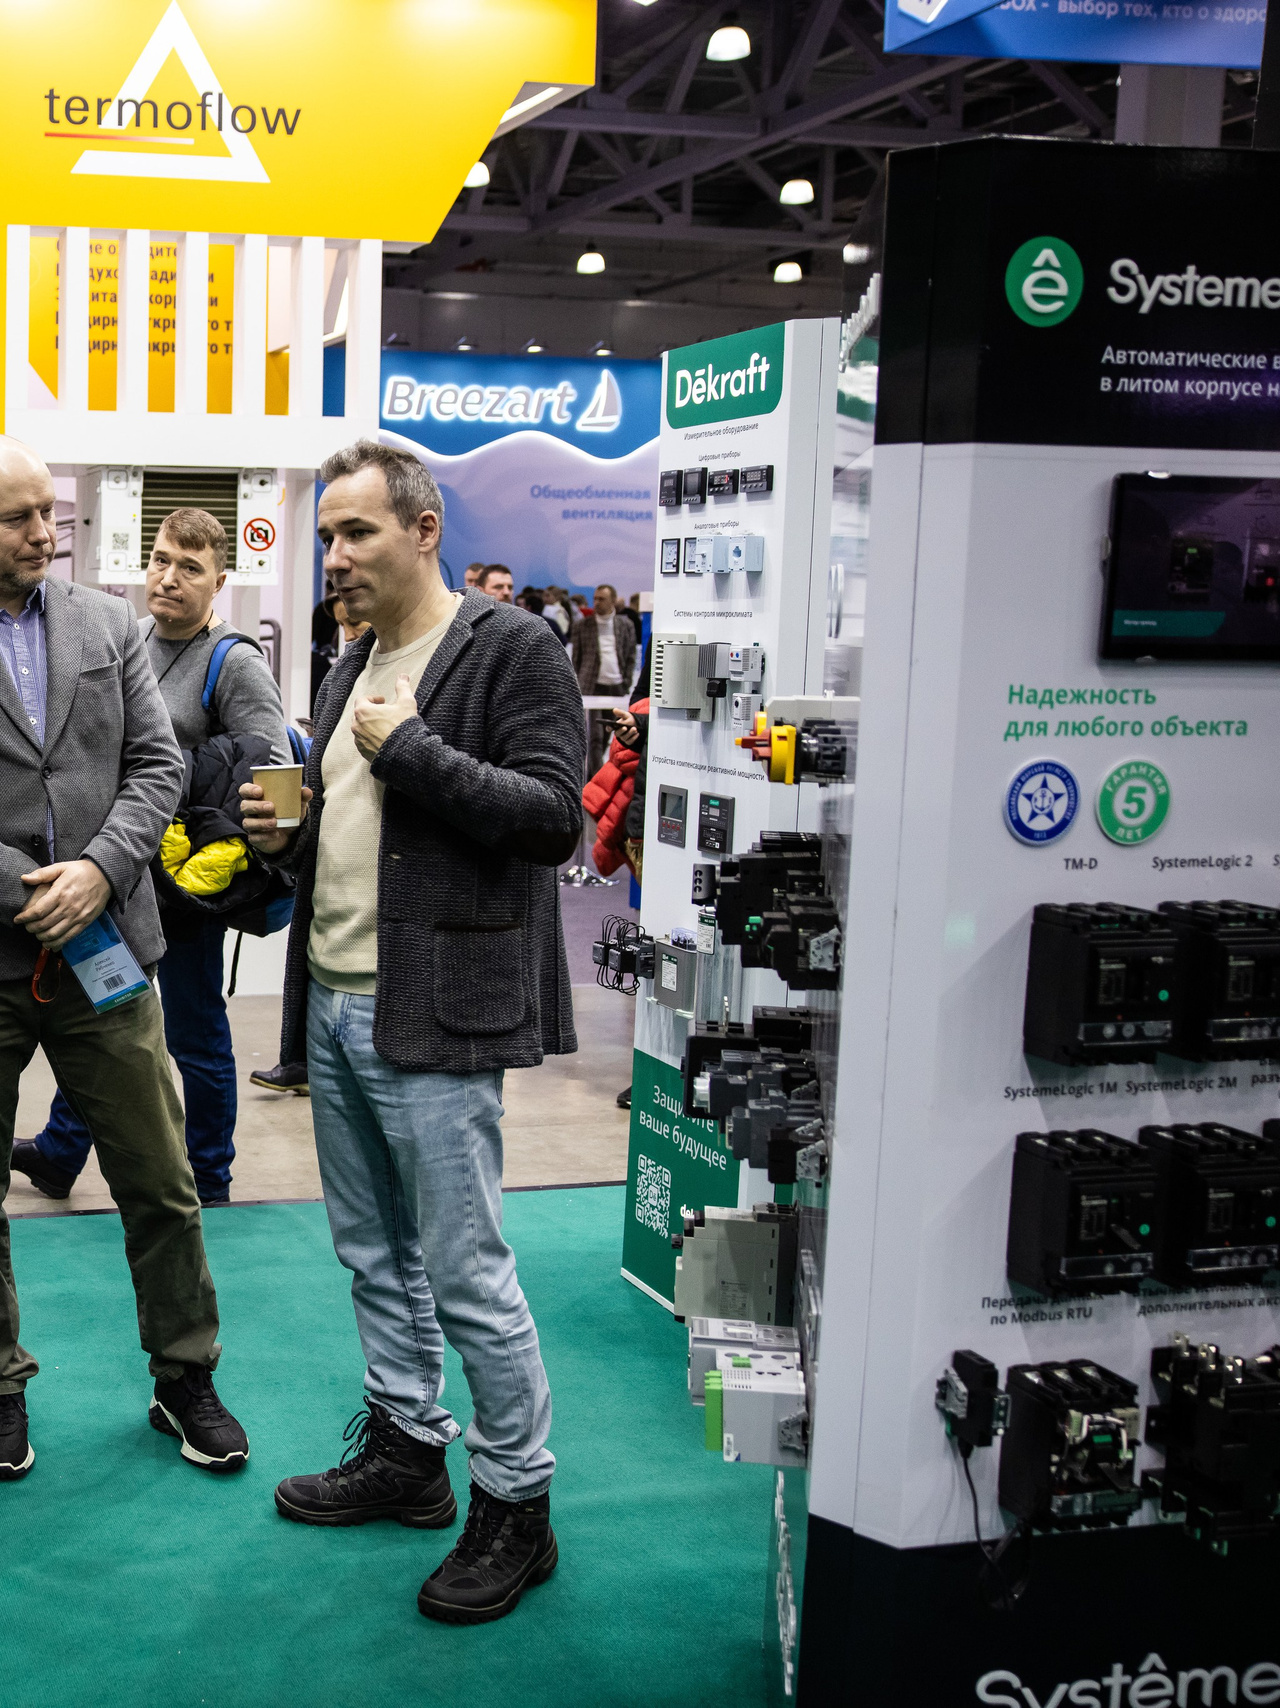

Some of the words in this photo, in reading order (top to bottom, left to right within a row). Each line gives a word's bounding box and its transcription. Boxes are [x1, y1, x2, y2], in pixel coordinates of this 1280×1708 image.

[44, 88, 302, 136] termoflow
[1101, 345, 1268, 370] Автоматические
[384, 376, 576, 423] Breezart
[1100, 377, 1112, 392] в
[1116, 378, 1180, 394] литом
[1185, 379, 1263, 401] корпусе
[530, 484, 651, 501] Общеобменная
[562, 508, 653, 523] вентиляция
[673, 609, 693, 618] Системы
[716, 610, 753, 619] микроклимата
[1008, 684, 1157, 709] Надежность
[1004, 720, 1048, 742] для
[1054, 715, 1144, 737] любого
[1150, 715, 1248, 737] объекта
[651, 755, 676, 765] Устройства
[707, 765, 737, 776] реактивной
[737, 771, 765, 781] мощности
[1105, 765, 1167, 795] ГАРАНТИЯ
[1122, 785, 1147, 819] 5
[1115, 827, 1142, 839] ЛЕТ
[1064, 857, 1098, 870] TM-D
[1152, 855, 1241, 871] SystemeLogic
[1245, 855, 1253, 867] 2
[1004, 1083, 1094, 1100] SystemeLogic
[1098, 1082, 1118, 1094] 1M
[1125, 1079, 1214, 1096] SystemeLogic
[1218, 1077, 1238, 1088] 2M
[639, 1110, 670, 1139] ваше
[672, 1125, 727, 1171] будущее
[990, 1315, 1007, 1325] по
[1011, 1309, 1062, 1324] Modbus
[1066, 1306, 1093, 1320] RTU
[1137, 1298, 1255, 1316] дополнительных
